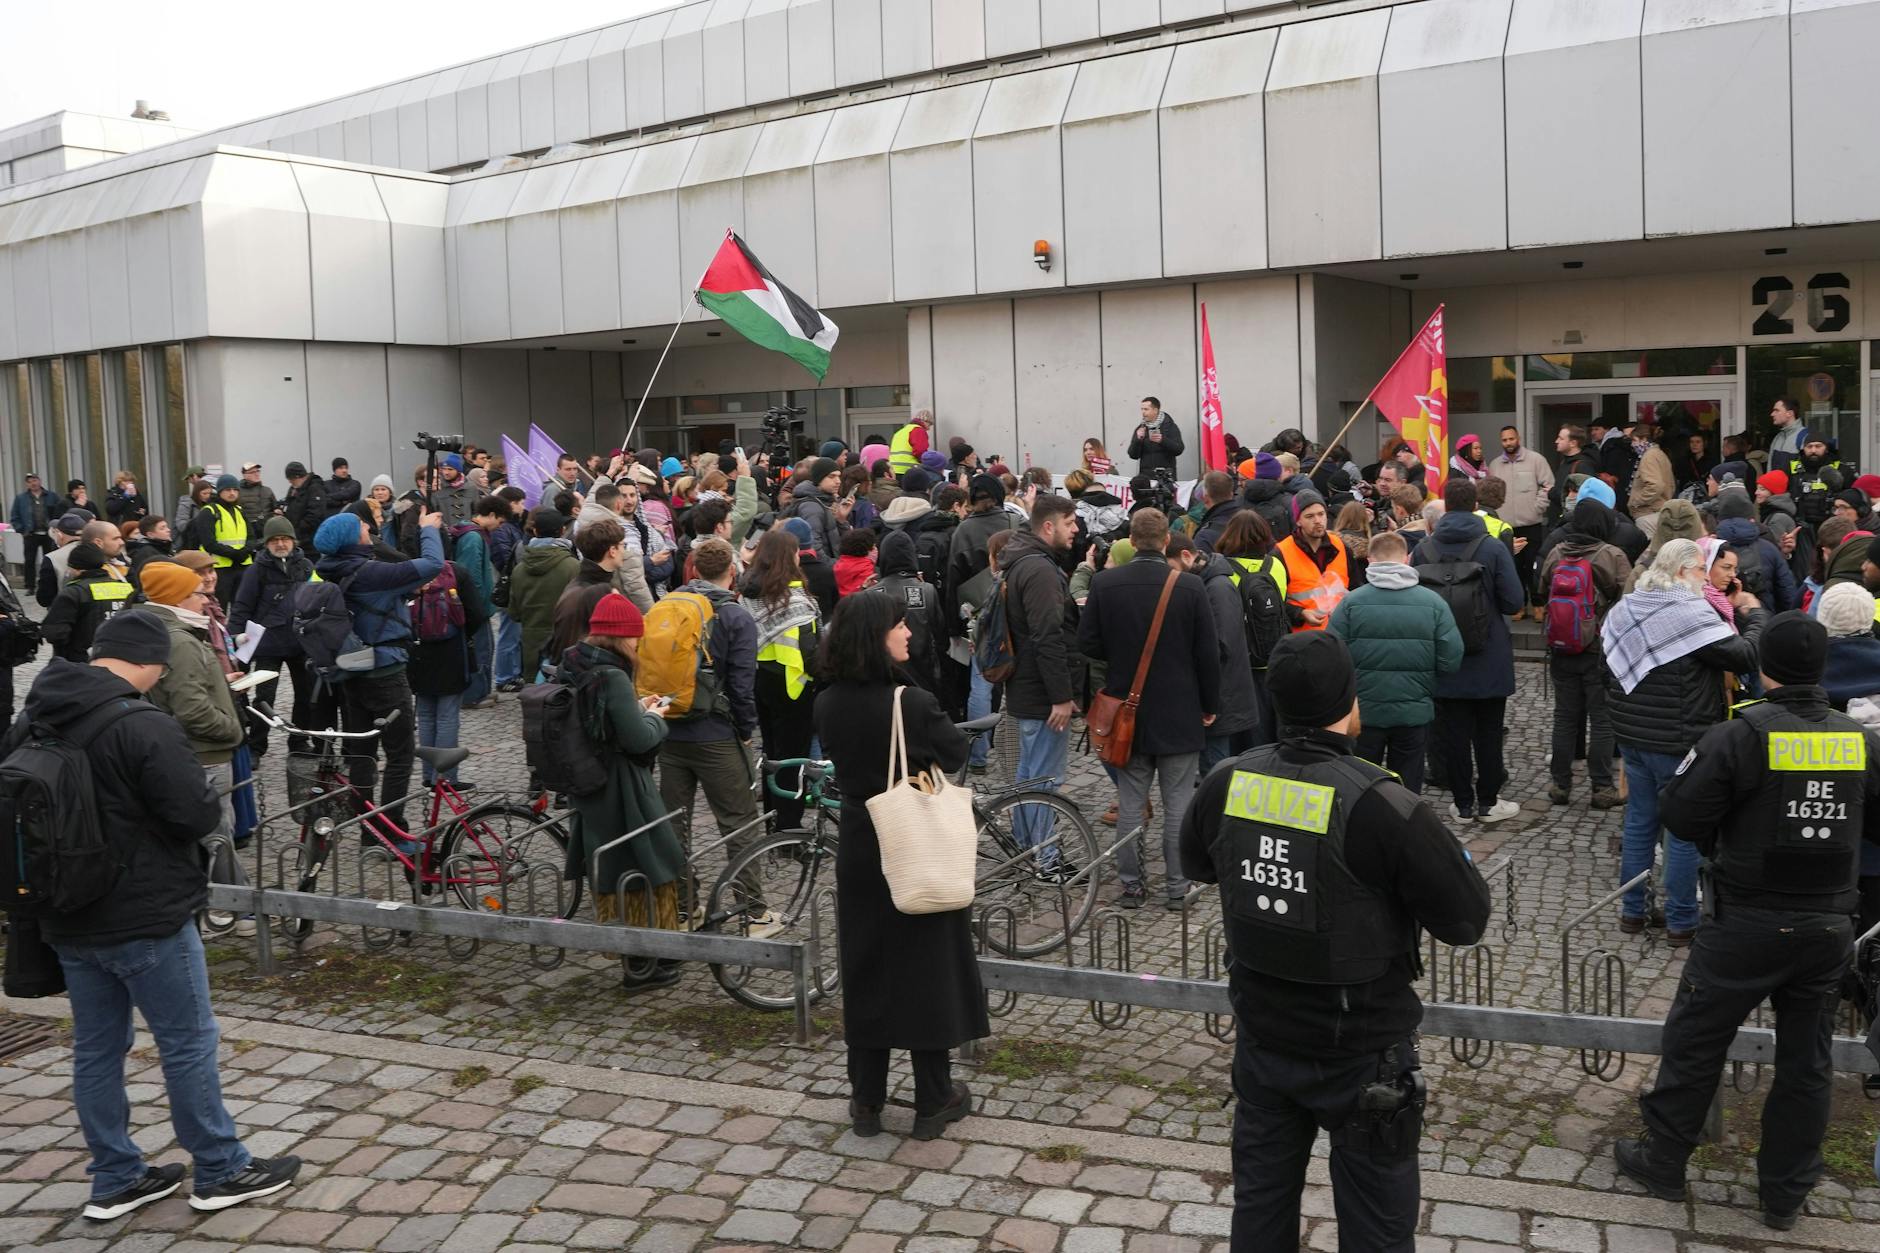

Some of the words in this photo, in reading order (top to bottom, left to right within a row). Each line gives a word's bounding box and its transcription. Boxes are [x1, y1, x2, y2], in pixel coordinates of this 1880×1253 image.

[1752, 272, 1850, 336] 26
[1774, 737, 1861, 766] POLIZEI
[1229, 774, 1329, 830] POLIZEI
[1806, 780, 1835, 799] BE
[1786, 800, 1848, 820] 16321
[1259, 835, 1290, 863] BE
[1240, 859, 1308, 893] 16331
